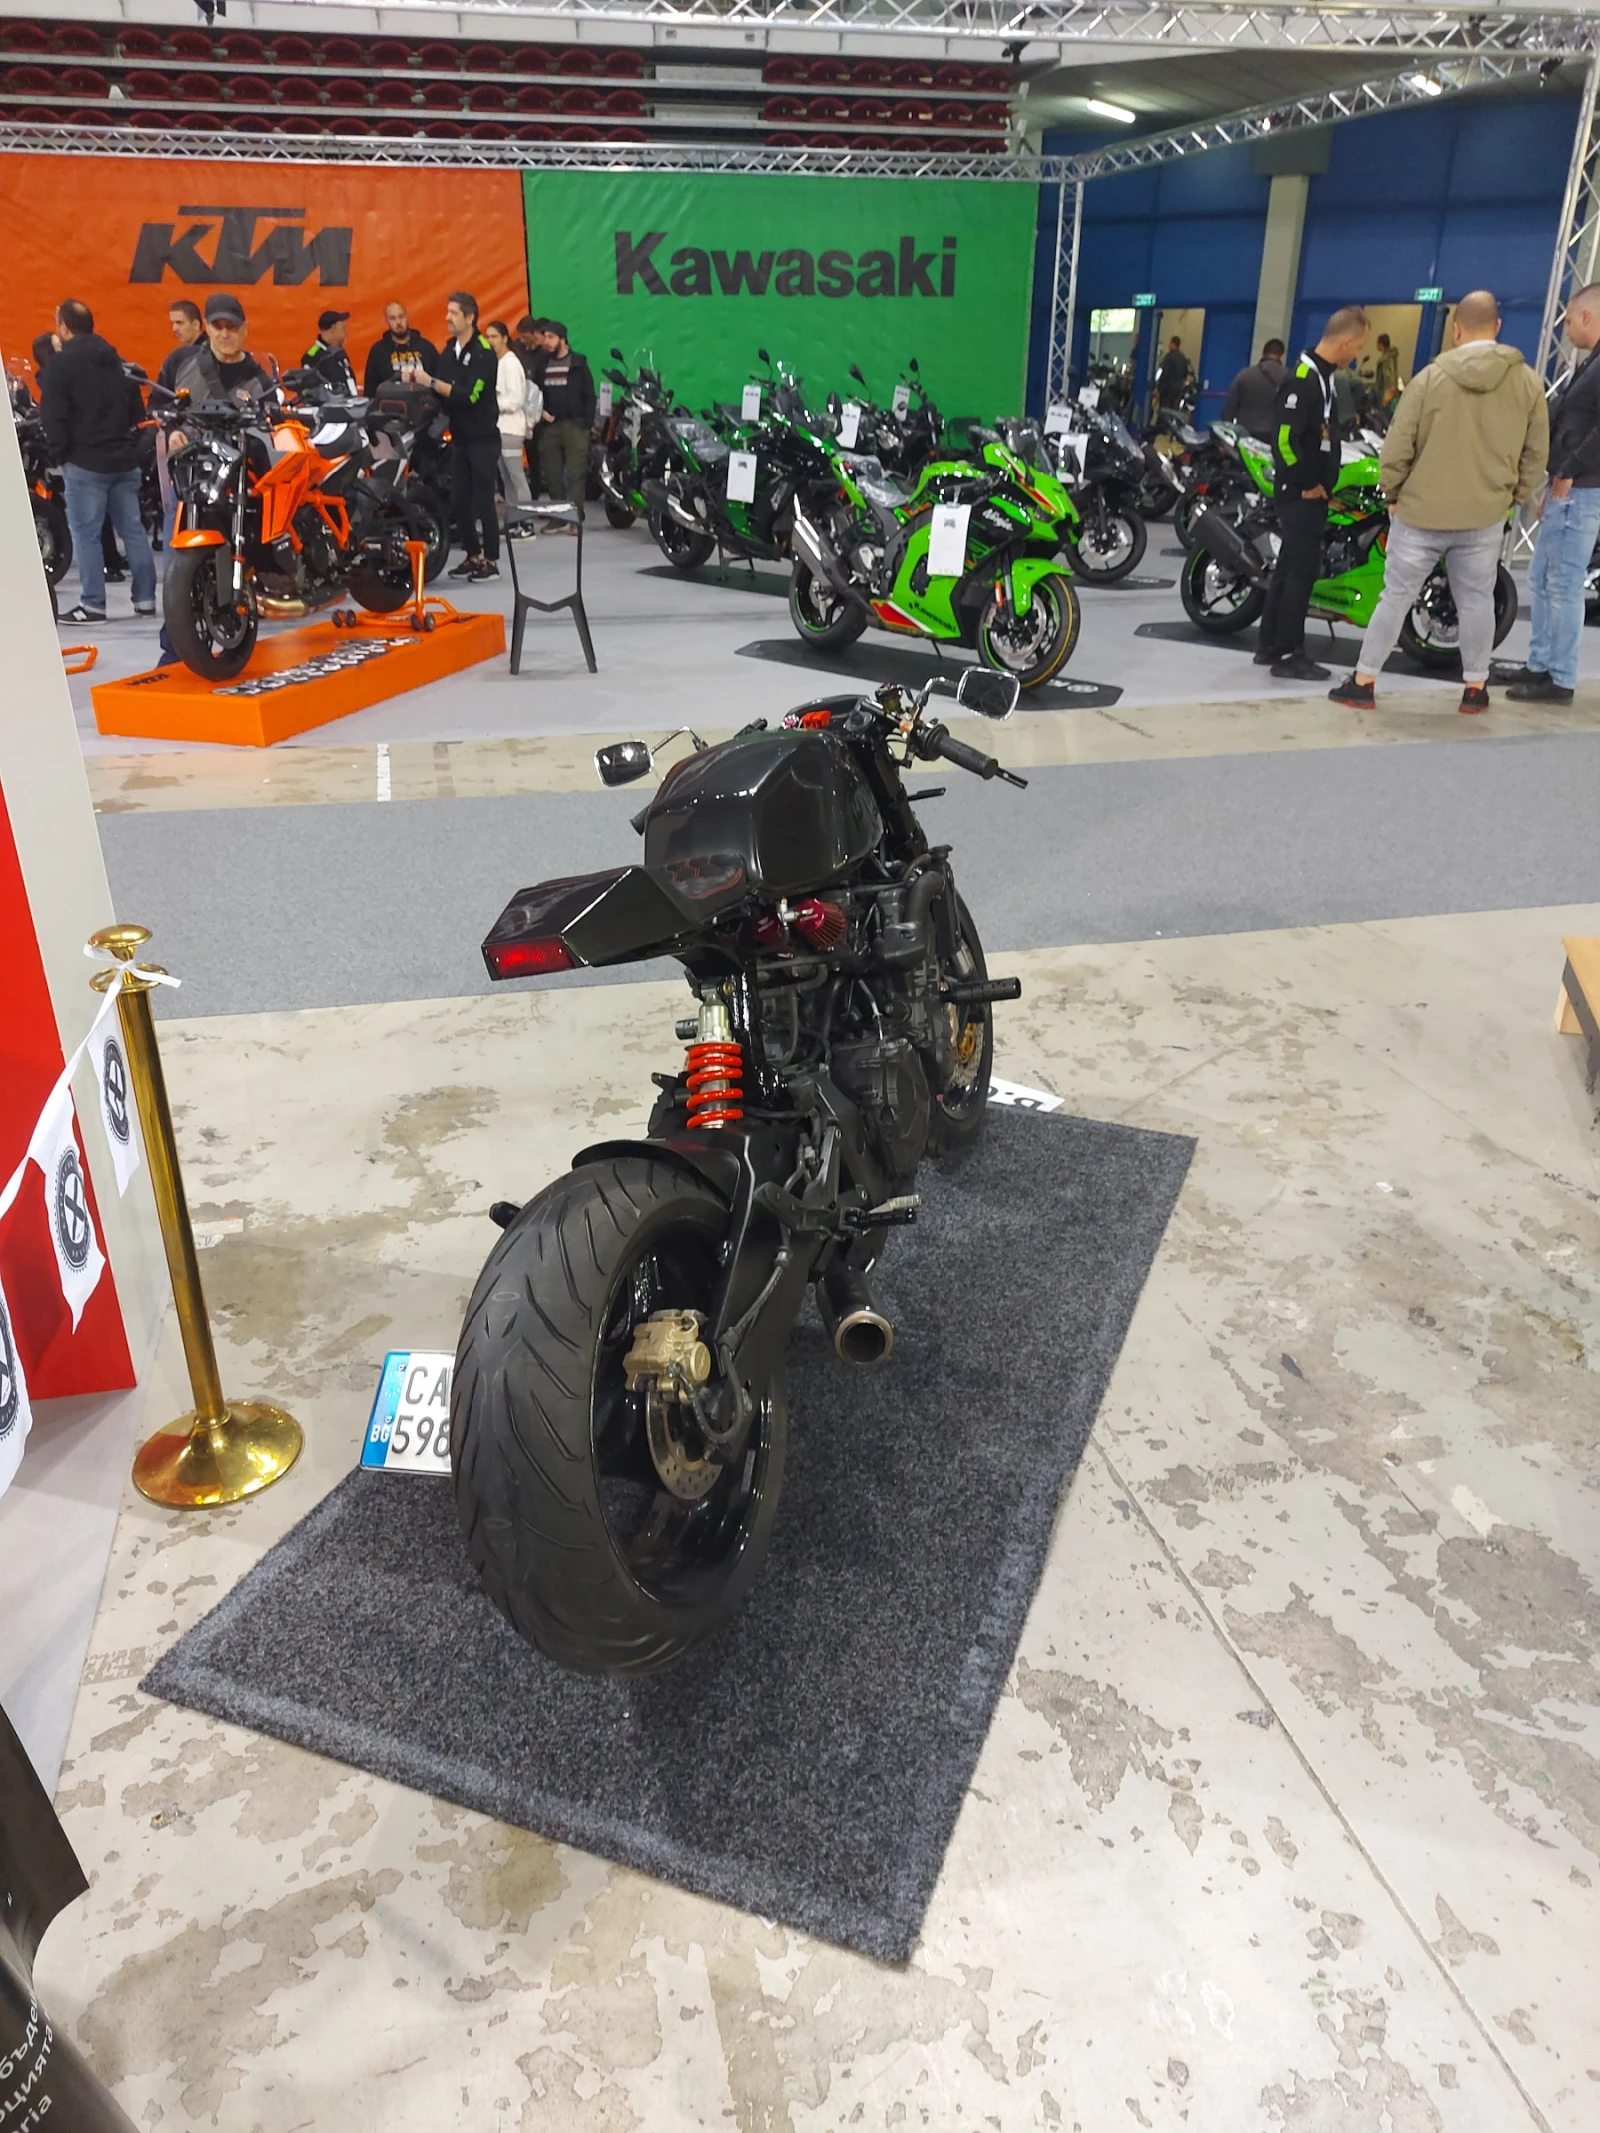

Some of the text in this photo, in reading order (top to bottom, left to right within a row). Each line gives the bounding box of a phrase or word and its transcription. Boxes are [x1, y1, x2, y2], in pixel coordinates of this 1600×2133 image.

[128, 205, 353, 287] KTM
[614, 231, 957, 299] Kawasaki
[405, 1366, 449, 1407] CA
[370, 1423, 392, 1443] BG
[11, 2094, 52, 2133] ria
